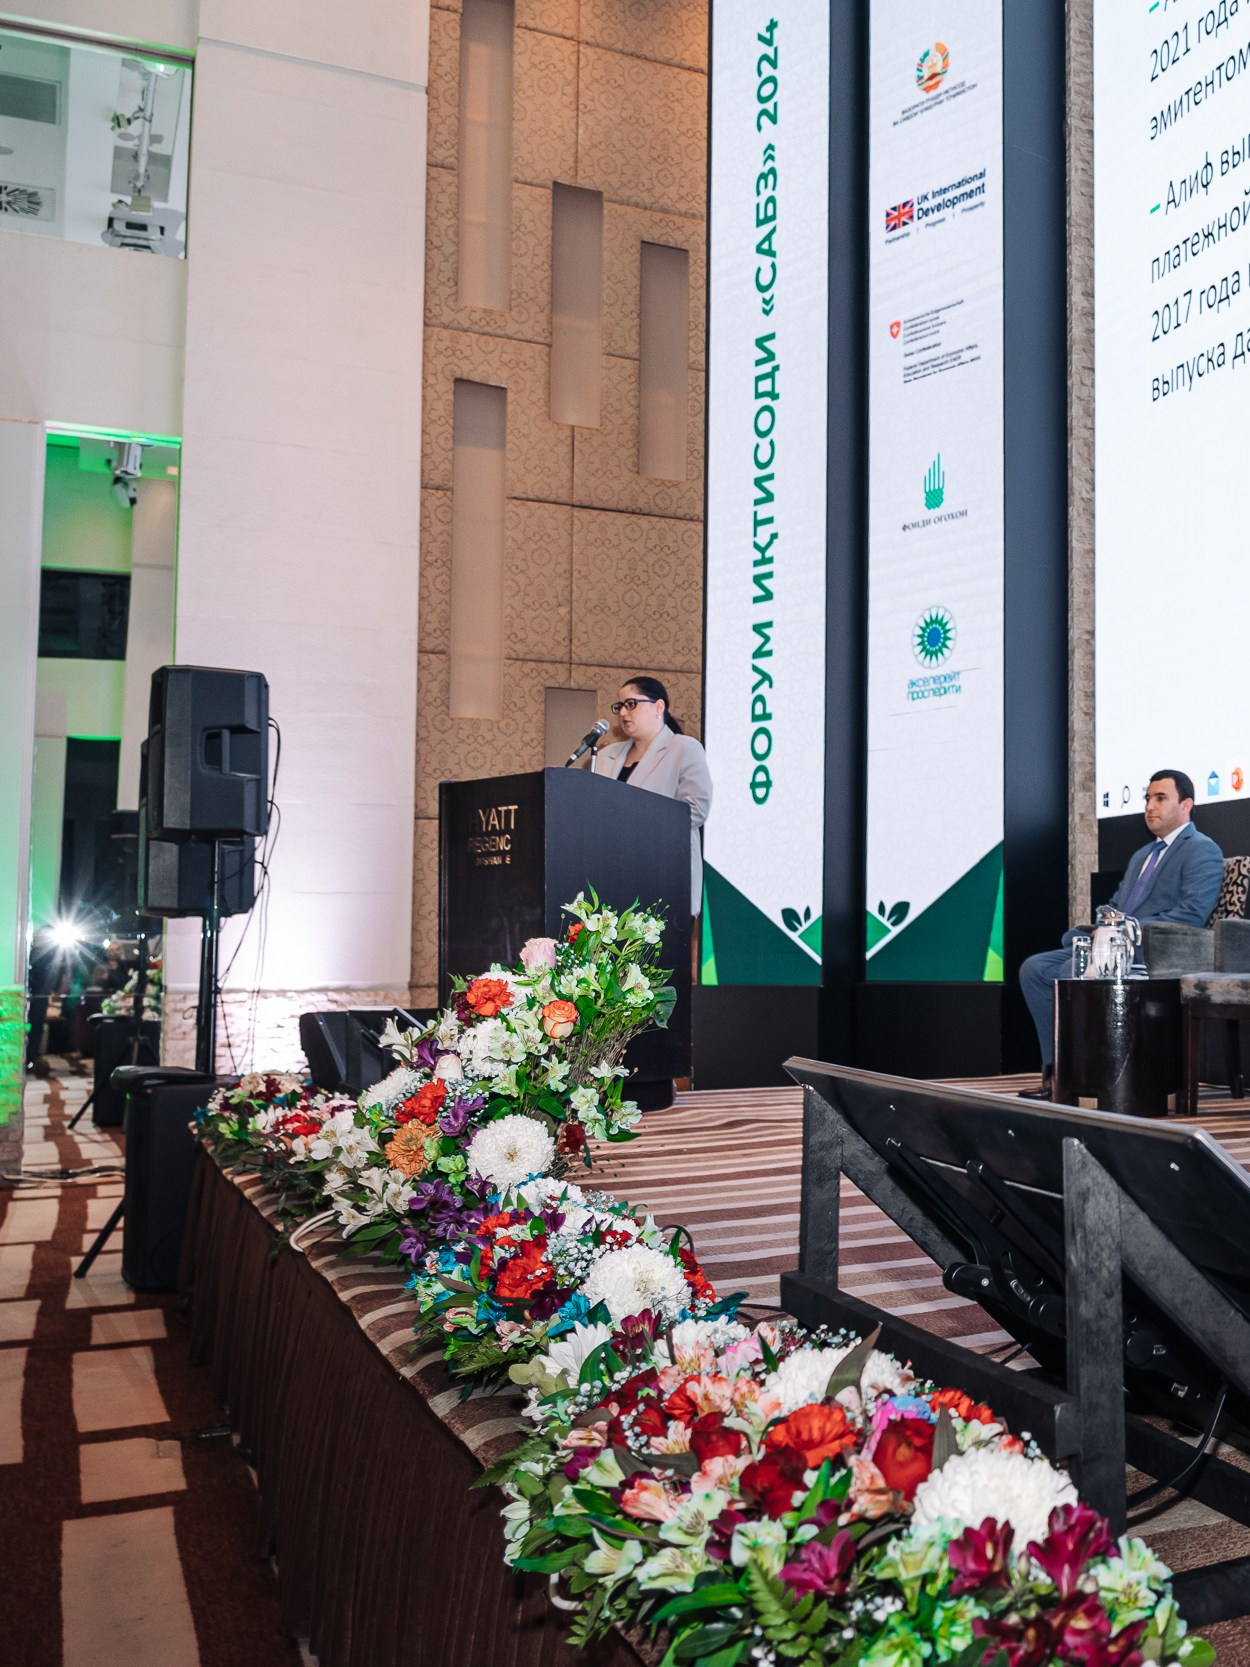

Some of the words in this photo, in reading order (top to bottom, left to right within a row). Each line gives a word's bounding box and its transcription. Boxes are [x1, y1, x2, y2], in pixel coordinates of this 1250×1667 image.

[755, 17, 779, 134] 2024
[1150, 22, 1191, 83] 2021
[1197, 0, 1239, 44] года
[916, 192, 930, 206] UK
[932, 167, 986, 199] International
[916, 182, 986, 221] Development
[1165, 152, 1214, 215] Алиф
[754, 142, 778, 317] «САБЗ»
[1151, 289, 1193, 343] 2017
[1199, 270, 1241, 315] года
[1152, 341, 1226, 403] выпуска
[752, 331, 781, 605] ИҚТИСОДИ
[749, 620, 774, 806] ФОРУМ
[471, 804, 519, 832] YATT
